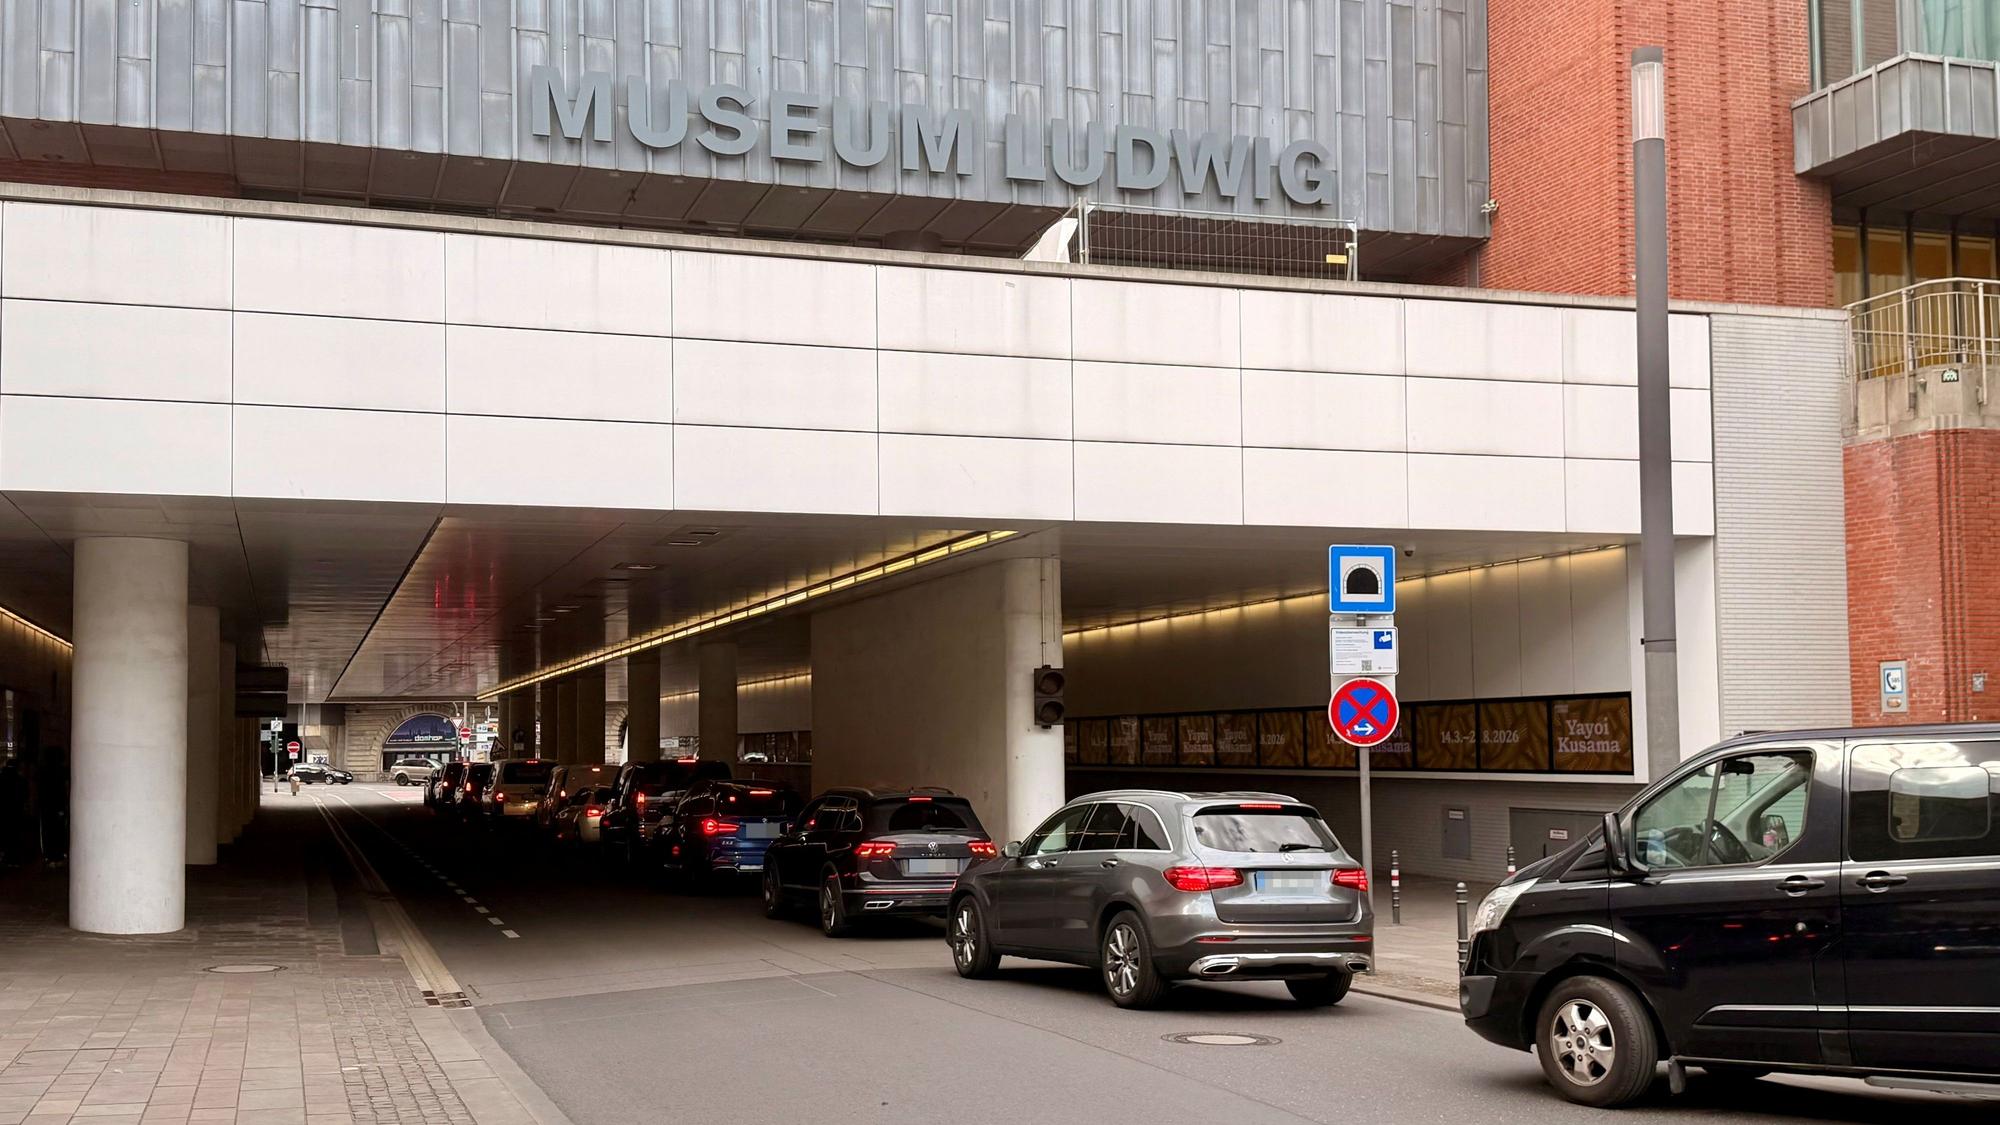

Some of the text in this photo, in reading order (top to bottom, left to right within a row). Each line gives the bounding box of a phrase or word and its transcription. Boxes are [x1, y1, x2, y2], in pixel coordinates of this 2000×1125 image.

[531, 64, 1336, 206] MUSEUM LUDWIG
[1566, 717, 1609, 739] Yayoi
[1557, 737, 1620, 752] Kusama
